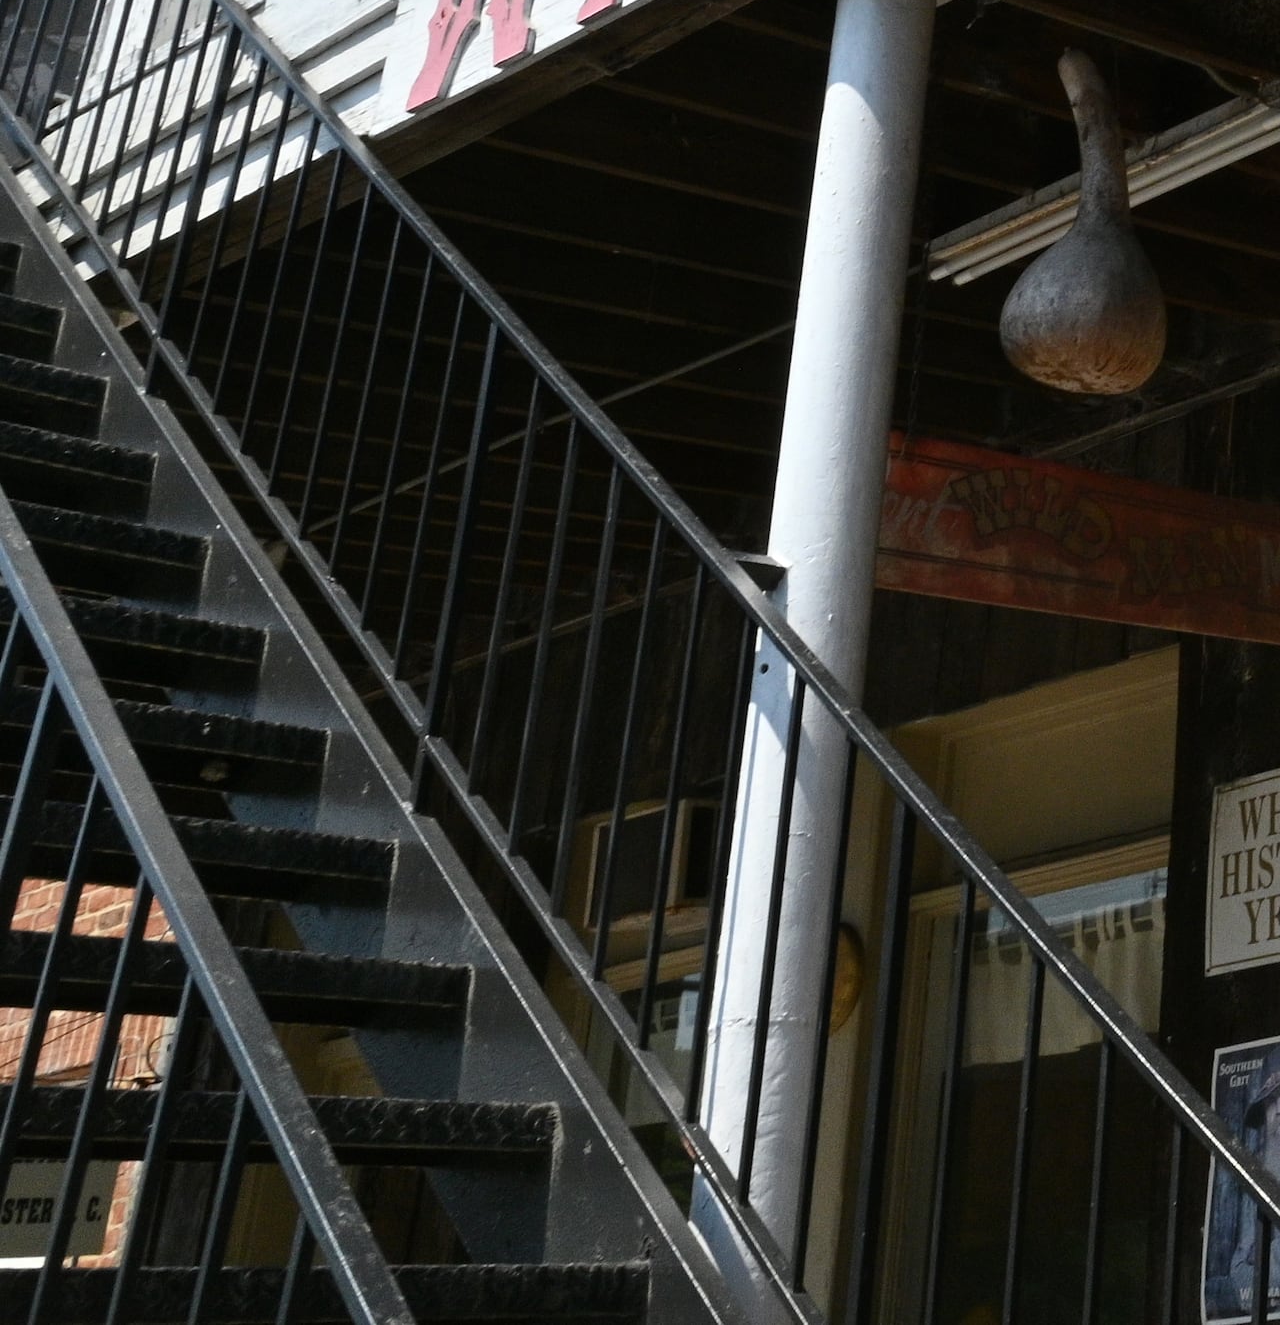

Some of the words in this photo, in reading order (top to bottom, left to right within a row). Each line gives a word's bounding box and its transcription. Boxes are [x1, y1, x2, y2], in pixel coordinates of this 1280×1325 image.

[951, 466, 1114, 561] WILD
[1219, 1056, 1264, 1076] SOUTHERN
[1229, 1074, 1250, 1089] GRIT
[1, 1197, 55, 1224] STER
